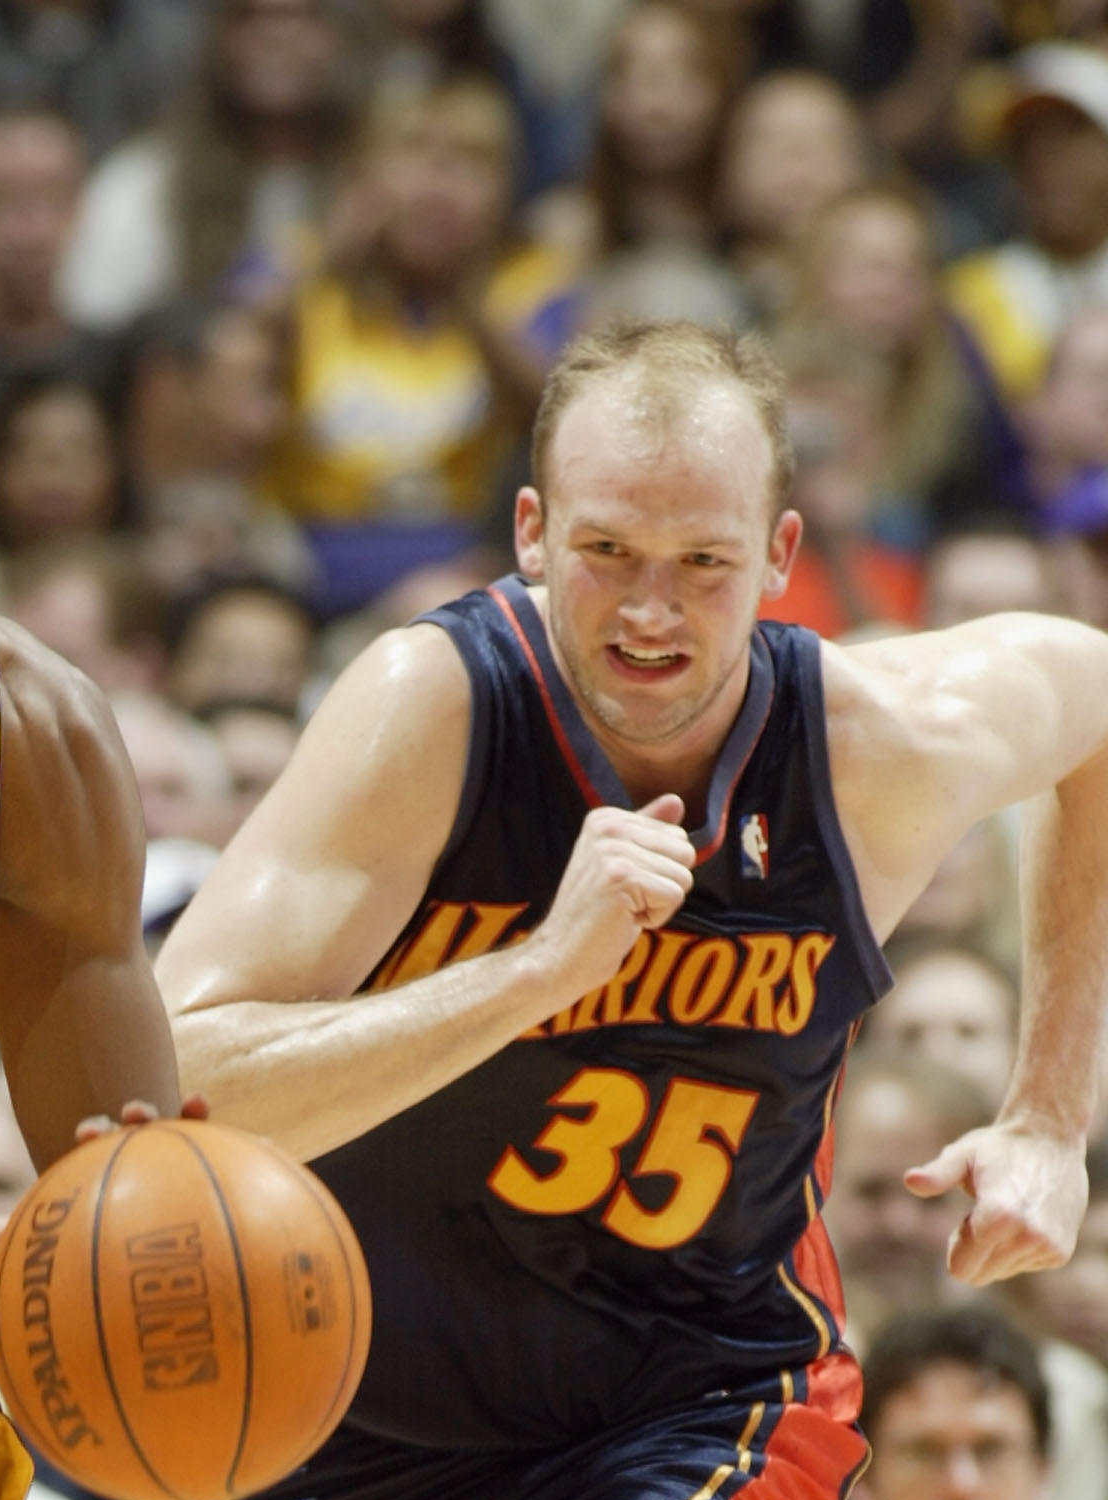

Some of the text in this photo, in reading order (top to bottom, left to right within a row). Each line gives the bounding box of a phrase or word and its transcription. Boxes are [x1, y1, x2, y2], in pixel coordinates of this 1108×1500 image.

[487, 1067, 760, 1251] 35
[23, 1185, 103, 1448] SPALDING
[126, 1222, 214, 1354] NBA
